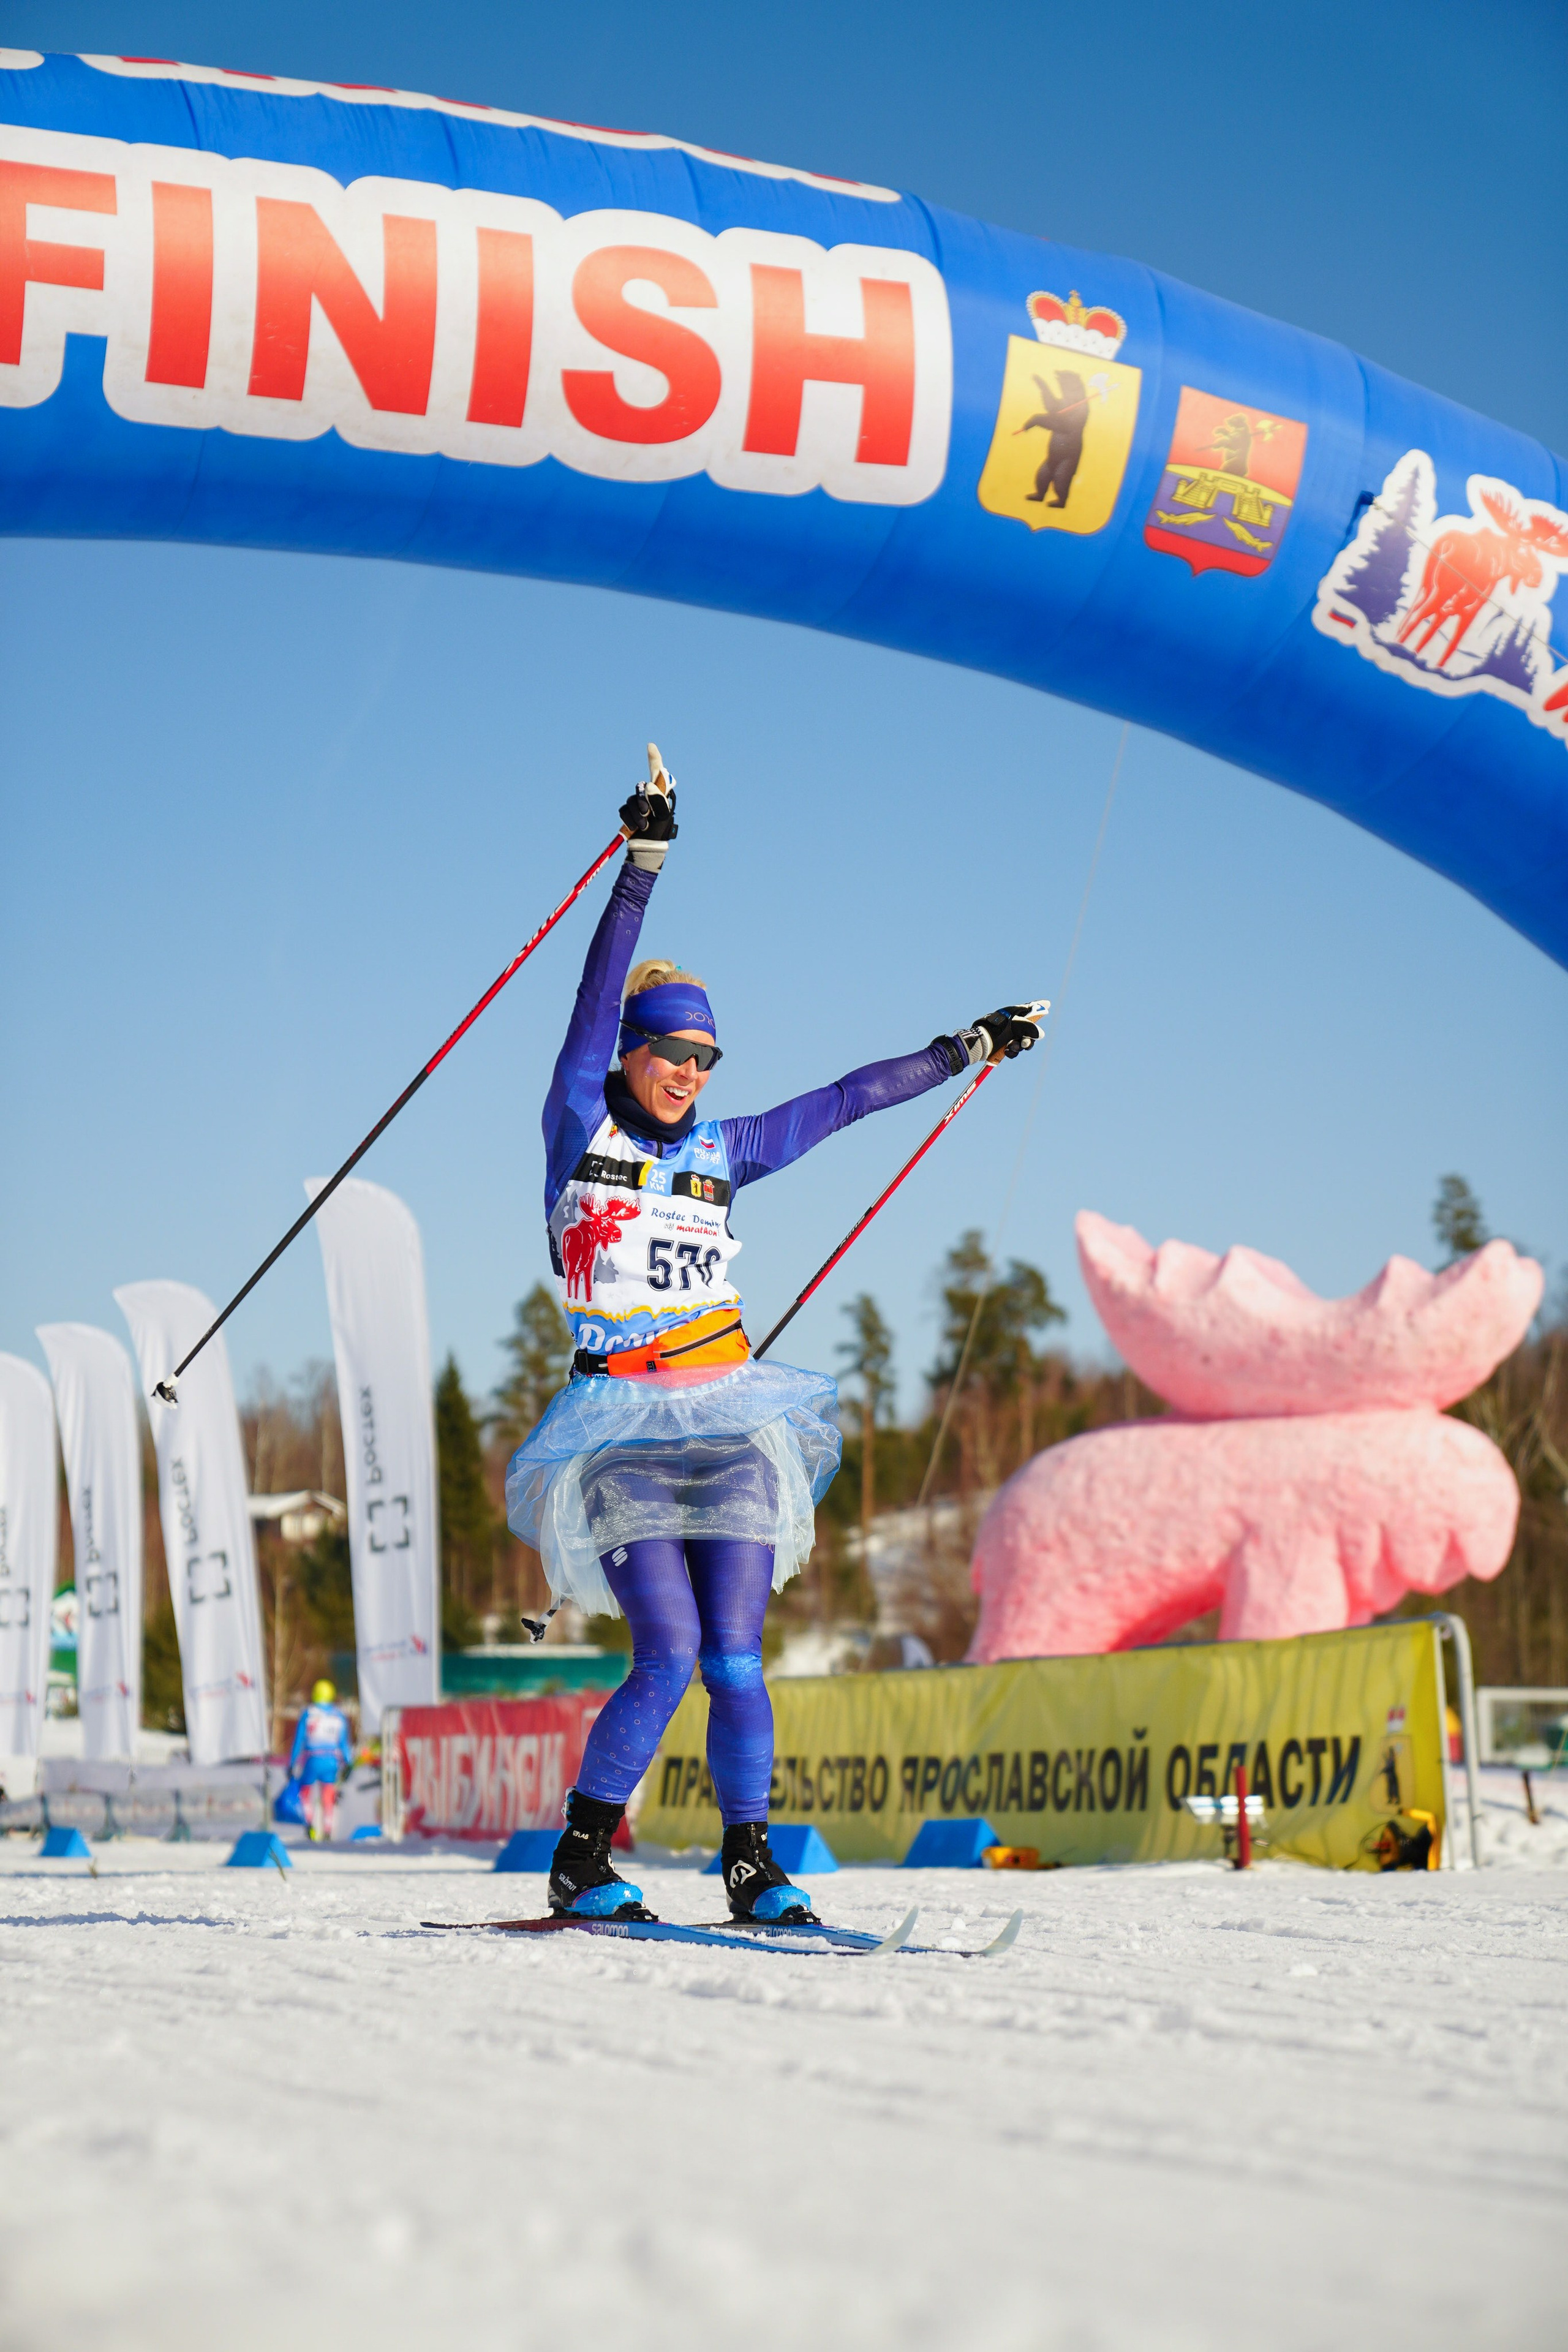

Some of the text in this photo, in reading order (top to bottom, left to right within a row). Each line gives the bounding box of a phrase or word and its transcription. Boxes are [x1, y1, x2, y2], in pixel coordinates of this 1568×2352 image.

[0, 160, 914, 466] FINISH
[601, 1170, 628, 1182] Rostec
[650, 1169, 666, 1185] 25
[649, 1181, 665, 1193] KM
[651, 1208, 722, 1228] Rostec Demin
[676, 1225, 717, 1236] marathon
[658, 1726, 1361, 1812] ПРАЕЛЬСТВО ЯРОСЛАВСКОЙ ОБЛАСТИ
